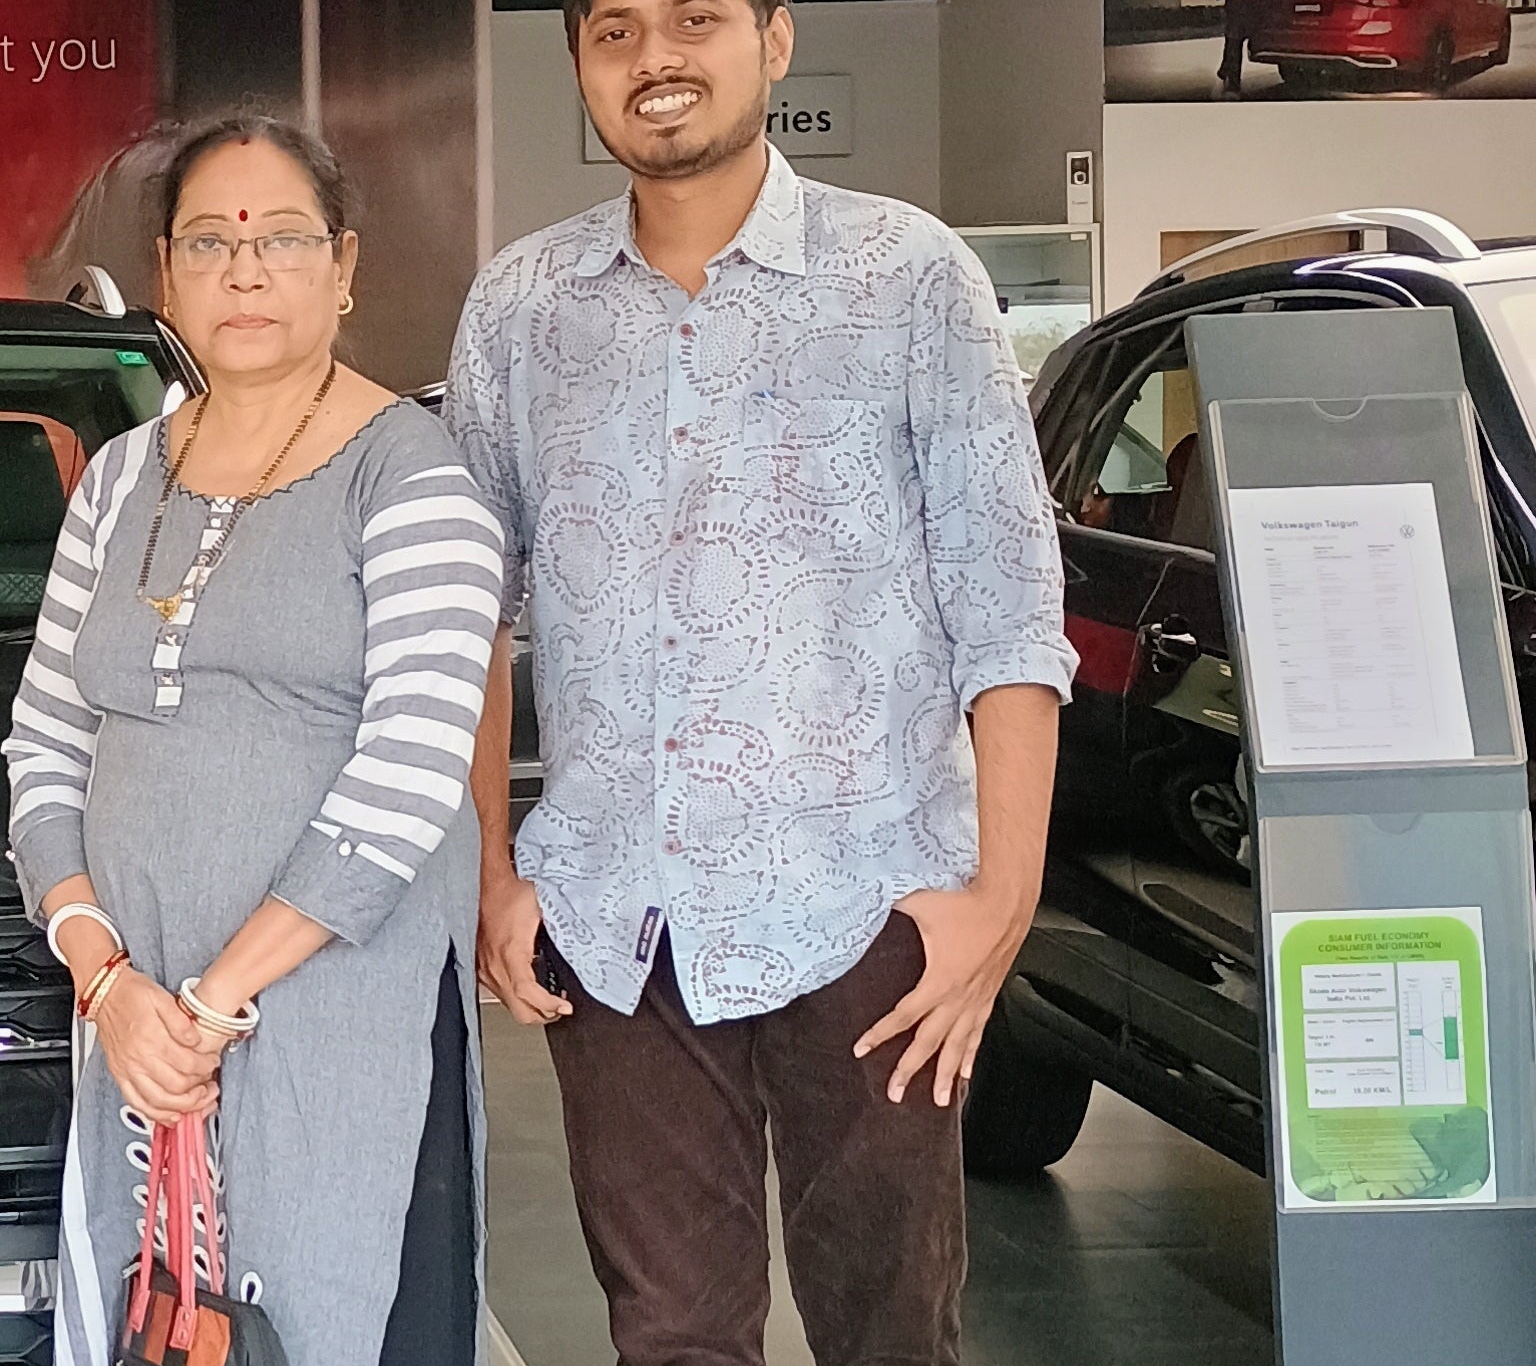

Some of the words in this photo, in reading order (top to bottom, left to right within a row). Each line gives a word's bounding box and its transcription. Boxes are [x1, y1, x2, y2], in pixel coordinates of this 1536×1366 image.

[31, 38, 116, 83] you
[1261, 521, 1323, 530] Volkswagen
[1324, 519, 1359, 529] Taigun
[1354, 932, 1379, 941] FUEL
[1381, 931, 1430, 941] ECONOMY
[1318, 943, 1374, 953] CONSUMER
[1375, 941, 1442, 951] INFORMATION
